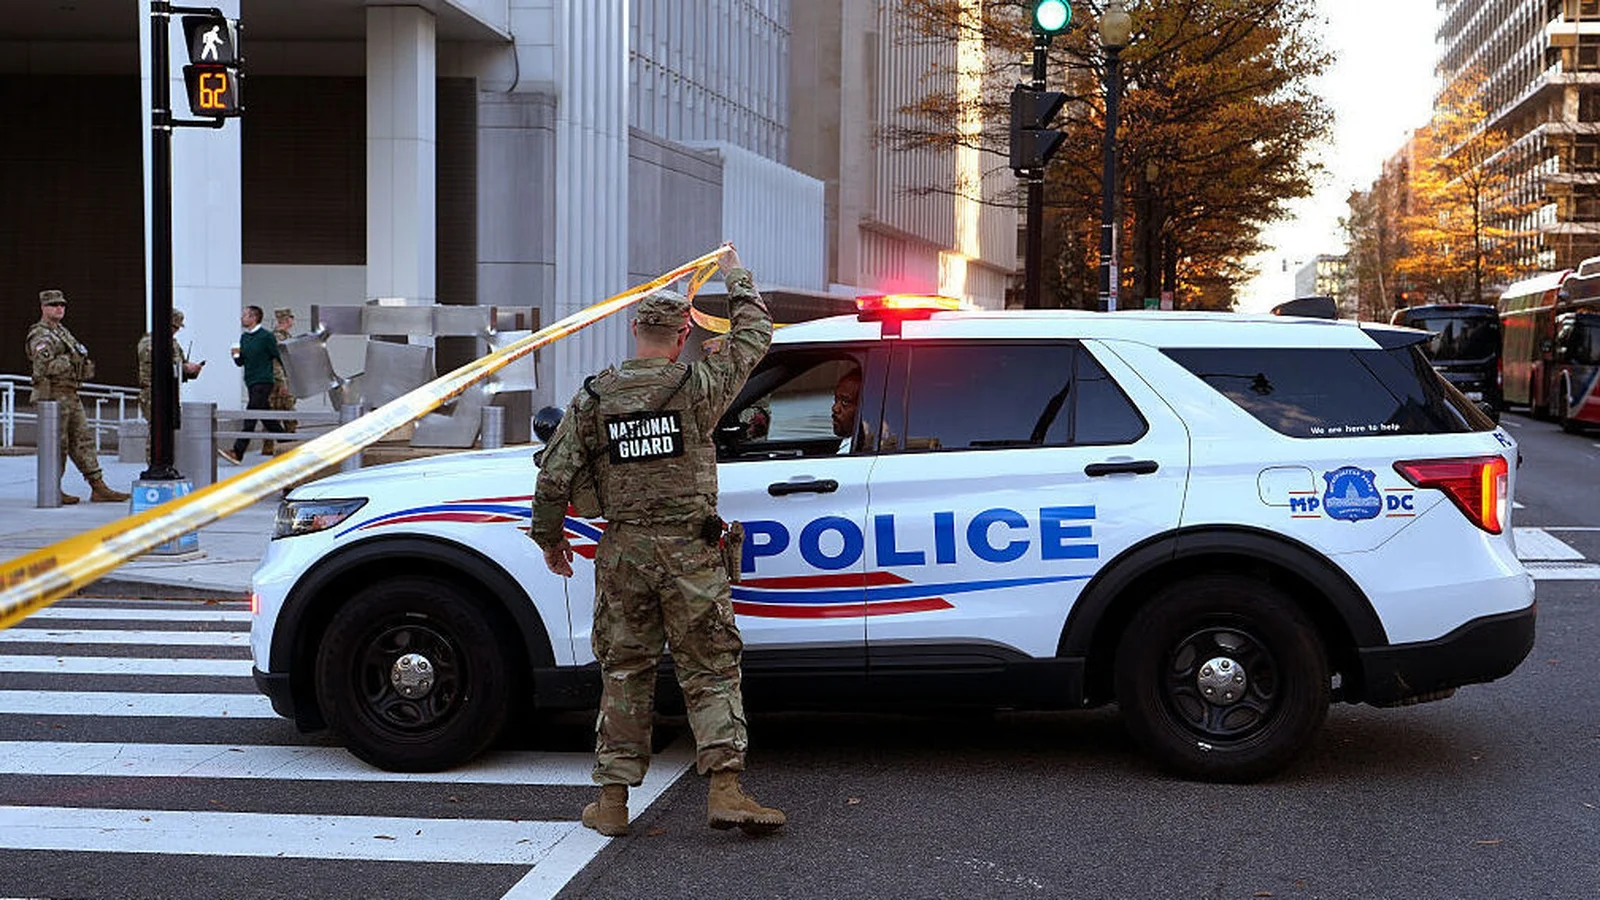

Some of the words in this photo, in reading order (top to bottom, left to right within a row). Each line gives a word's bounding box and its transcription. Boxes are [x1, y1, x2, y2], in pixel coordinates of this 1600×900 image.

[199, 73, 227, 108] 62
[608, 415, 680, 440] NATIONAL
[1310, 426, 1325, 434] We
[1328, 426, 1342, 434] are
[1345, 424, 1366, 433] here
[1368, 423, 1378, 431] to
[1380, 423, 1400, 431] help
[619, 436, 674, 458] GUARD
[1289, 497, 1320, 513] MP
[1385, 494, 1414, 510] DC
[741, 505, 1099, 574] POLICE
